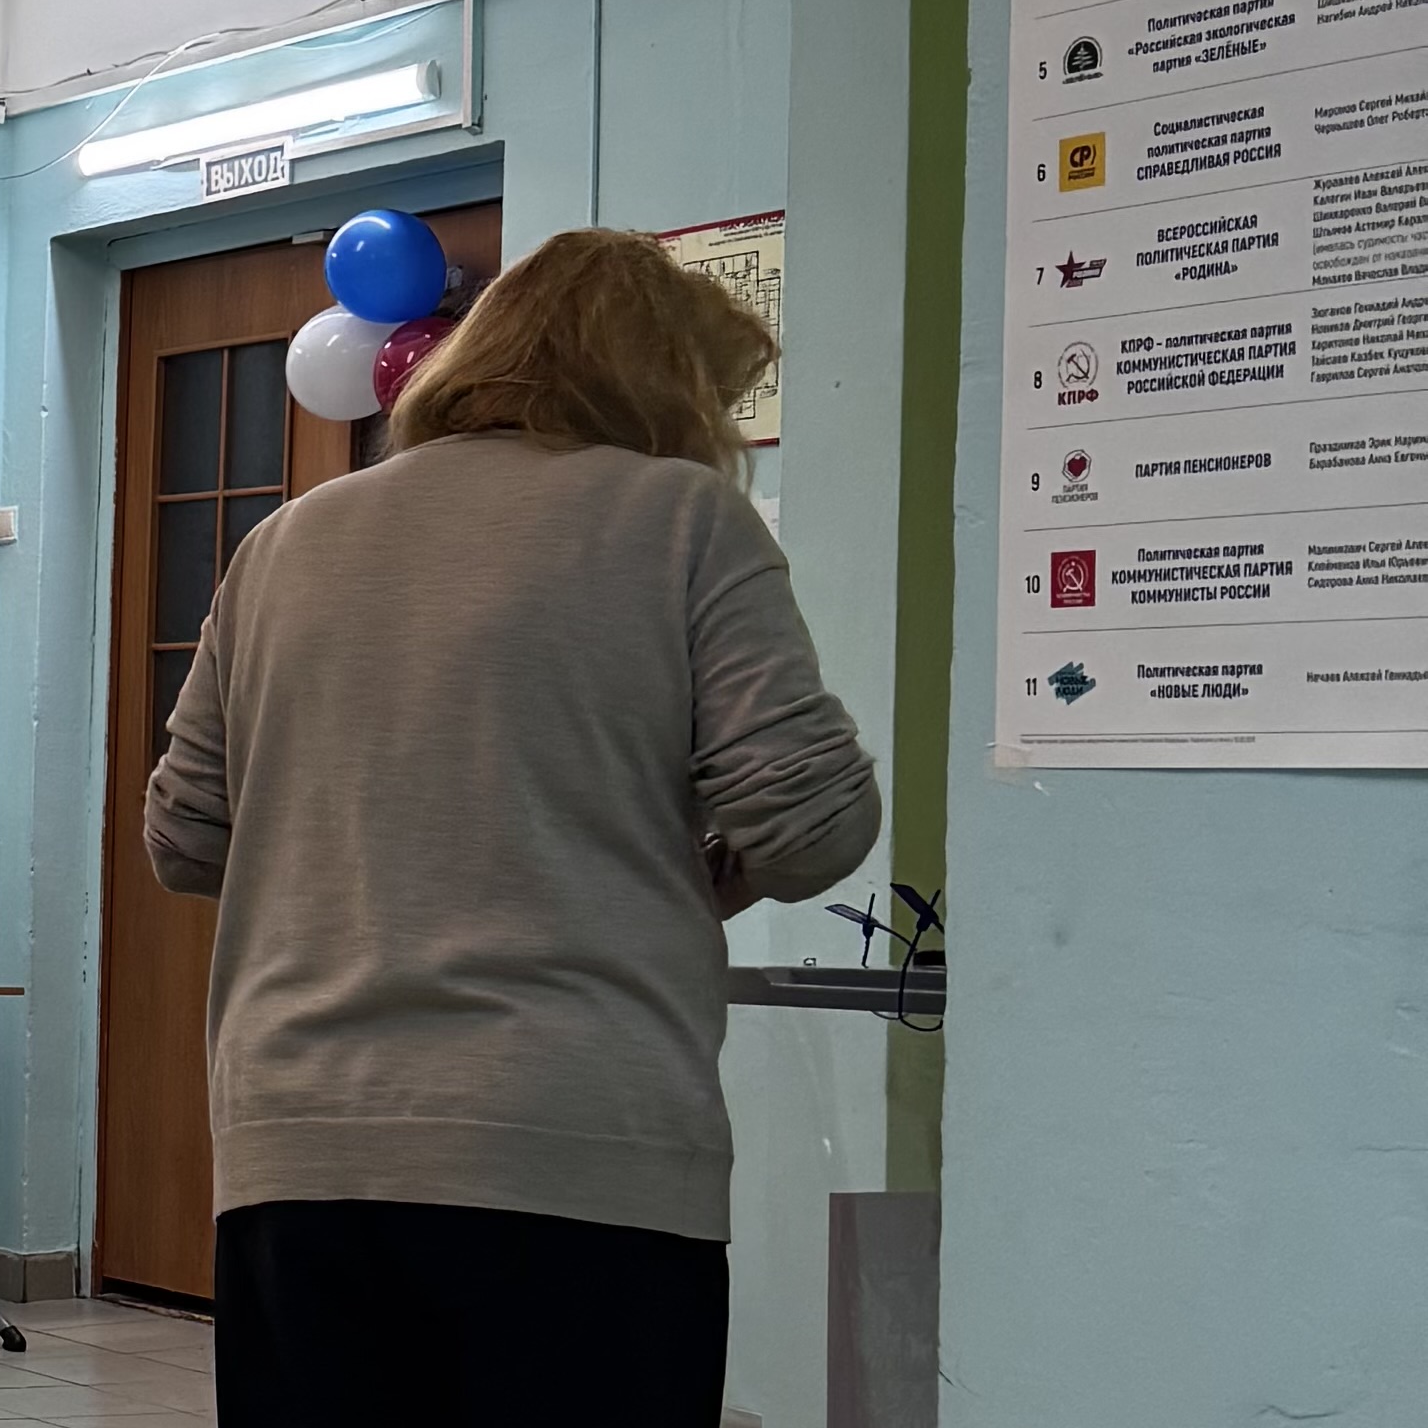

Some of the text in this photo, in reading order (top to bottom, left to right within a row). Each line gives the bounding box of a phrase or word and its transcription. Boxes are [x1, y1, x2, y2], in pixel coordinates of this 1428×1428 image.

[1147, 3, 1230, 33] Политическая
[1128, 12, 1296, 57] «Российская экологическая
[1038, 61, 1048, 79] 5
[1152, 55, 1192, 74] партия
[1154, 105, 1265, 137] Социалистическая
[1147, 125, 1272, 160] политическая партия
[210, 150, 285, 193] ВЫХОД
[1037, 163, 1046, 182] 6
[1136, 143, 1282, 182] СПРАВЕДЛИВАЯ РОССИЯ
[1157, 213, 1258, 244] ВСЕРОССИЙСКАЯ
[1136, 231, 1279, 268] ПОЛИТИЧЕСКАЯ ПАРТИЯ
[1036, 267, 1044, 285] 7
[1174, 260, 1239, 282] «РОДИНА»
[1120, 322, 1292, 355] КПРФ политическая партия
[1116, 340, 1296, 375] КОММУНИСТИЧЕСКАЯ ПАРТИЯ
[1033, 371, 1043, 389] 8
[1127, 364, 1284, 395] РОССИЙСКОЙ ФЕДЕРАЦИИ
[1057, 388, 1100, 407] КПРФ
[1135, 452, 1272, 479] ПАРТИЯ ПЕНСИОНЕРОВ
[1031, 472, 1040, 492] 9
[1138, 543, 1265, 563] Политическая партия
[1026, 574, 1041, 594] 10
[1111, 560, 1293, 586] КОММУНИСТИЧЕСКАЯ ПАРТИЯ
[1131, 584, 1271, 605] КОММУНИСТЫ РОССИИ
[1137, 663, 1263, 680] Политическая партия
[1026, 677, 1038, 696] 11
[1149, 682, 1249, 700] «НОВЫЕ ЛЮДИ»
